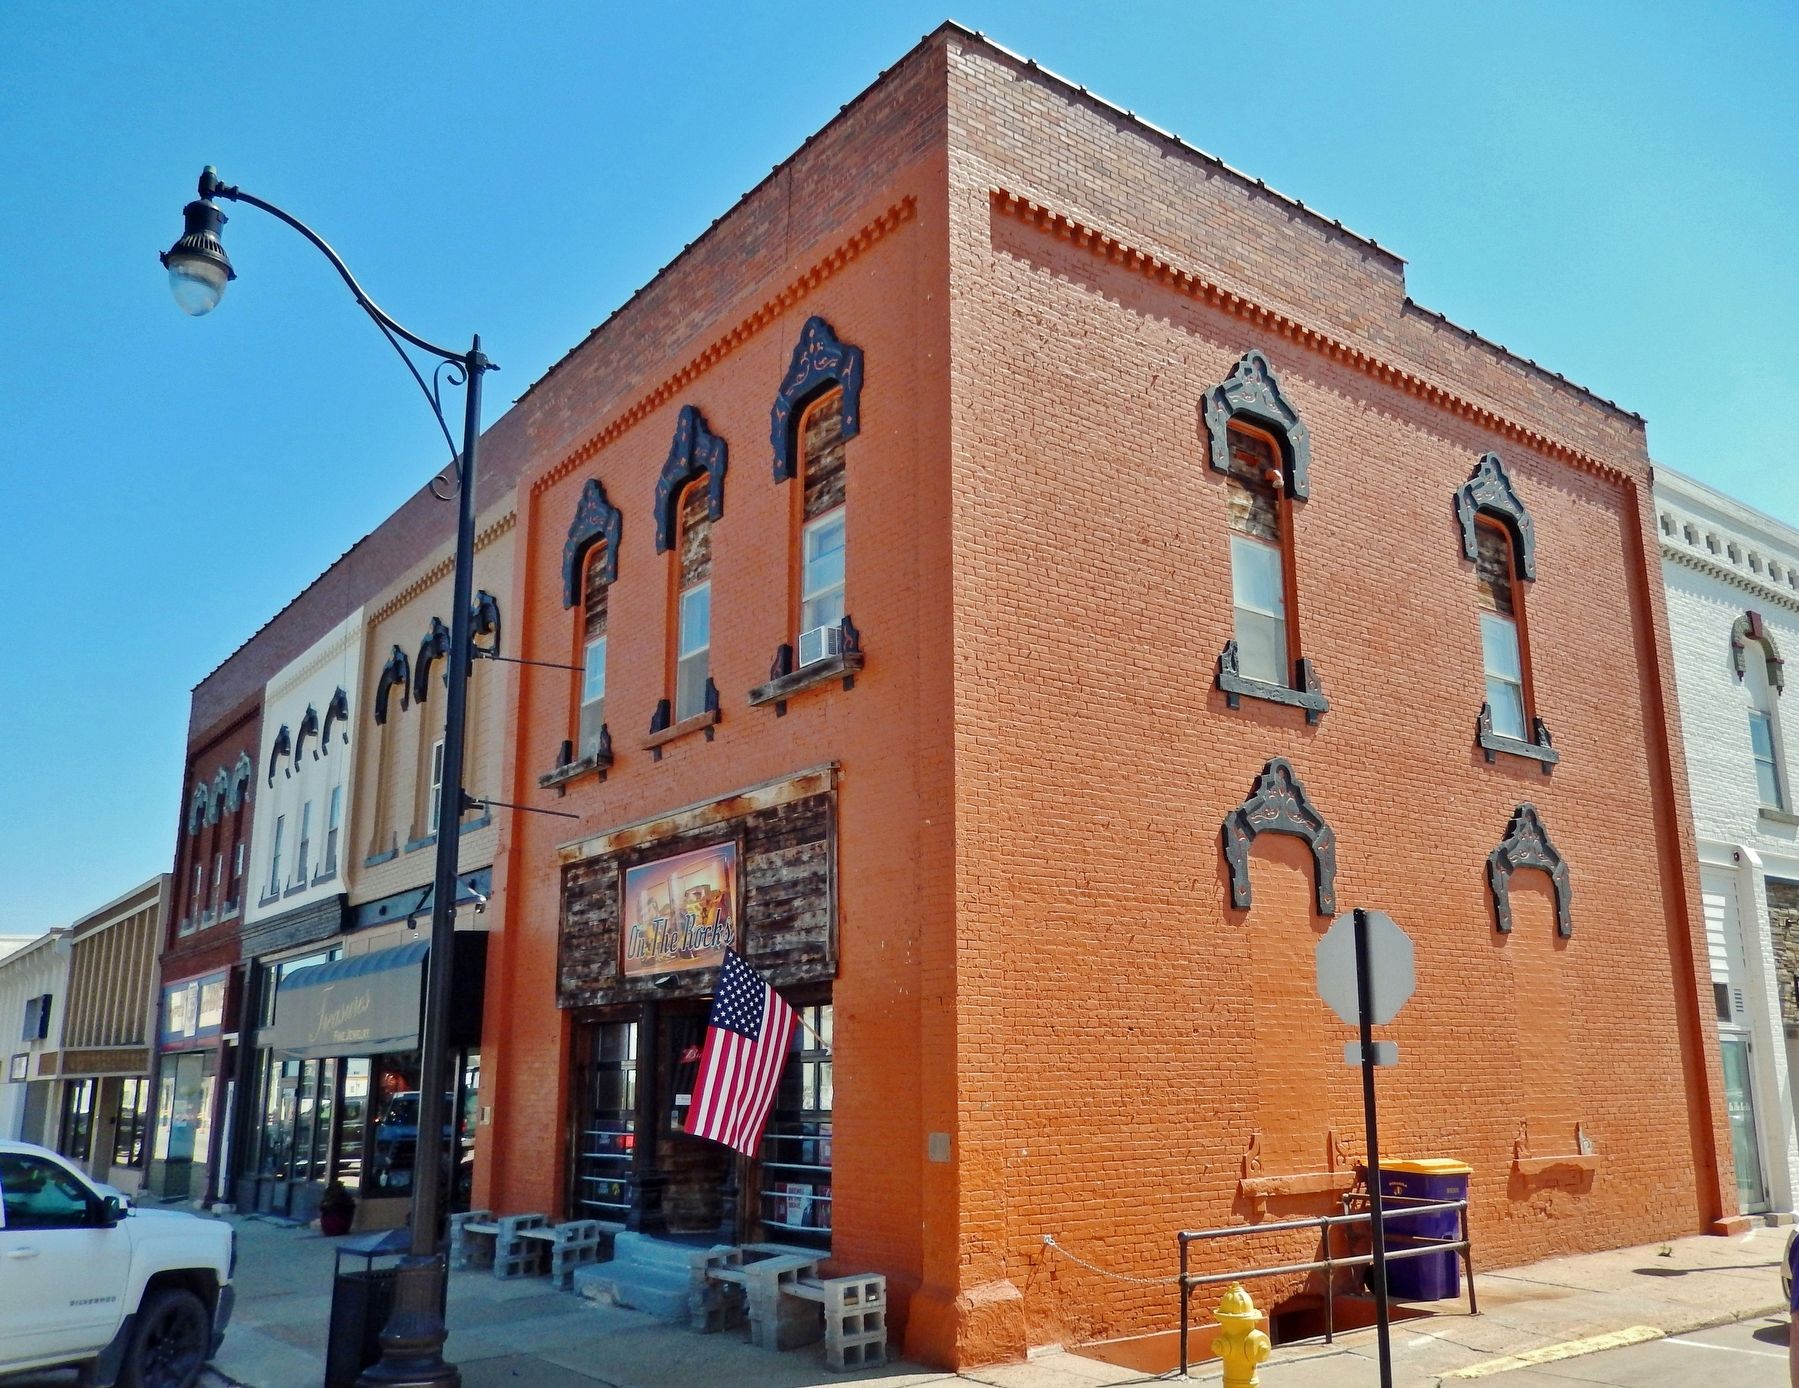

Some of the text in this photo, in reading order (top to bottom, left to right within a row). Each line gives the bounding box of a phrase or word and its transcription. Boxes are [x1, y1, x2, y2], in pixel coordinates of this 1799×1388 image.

[627, 908, 735, 961] On The Rocks
[70, 1296, 116, 1306] SILVERADO
